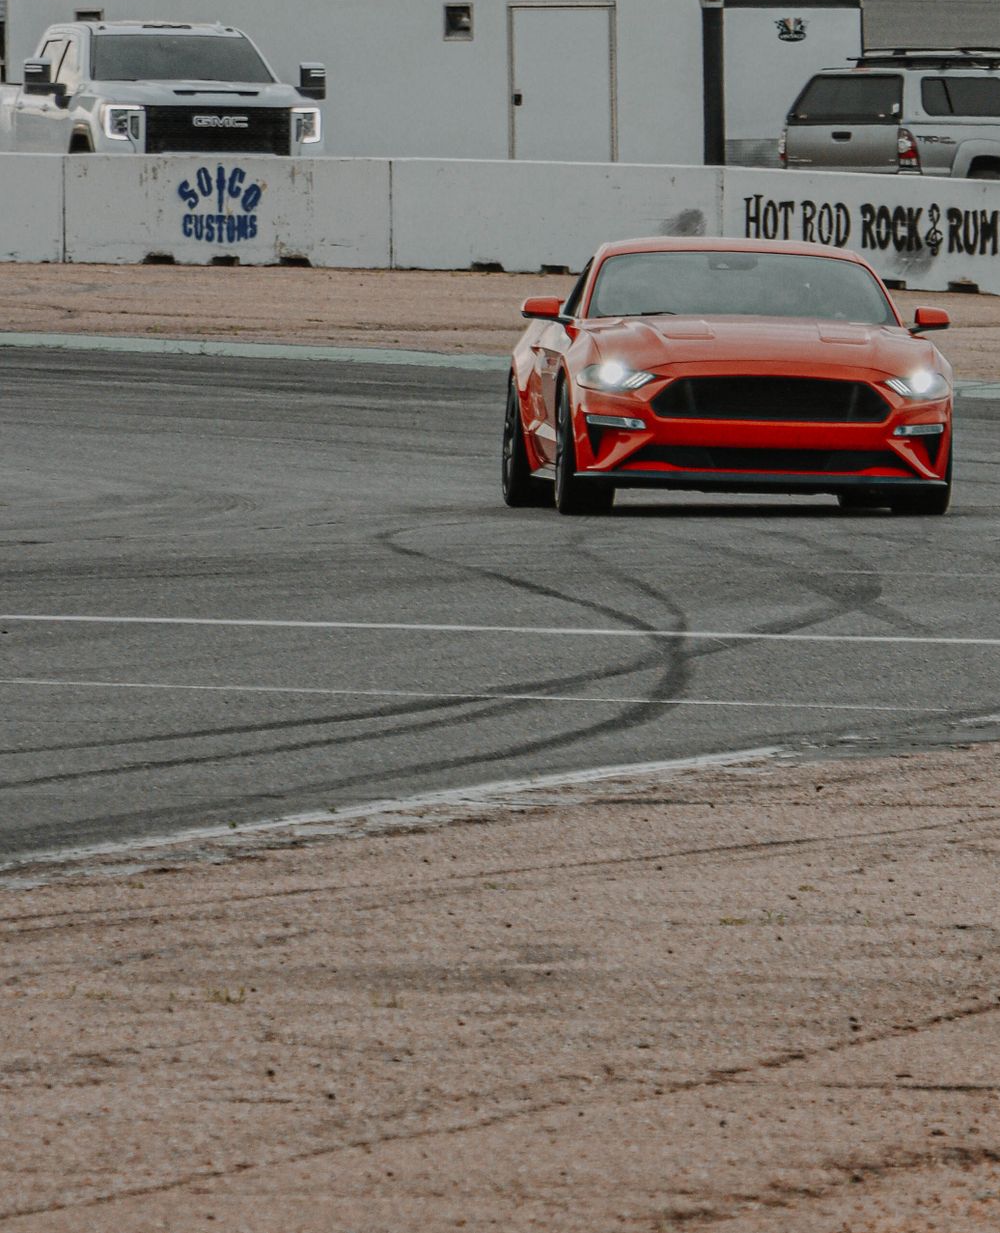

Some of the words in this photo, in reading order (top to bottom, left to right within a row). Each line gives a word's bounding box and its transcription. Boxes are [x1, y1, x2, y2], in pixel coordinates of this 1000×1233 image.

[192, 115, 249, 128] GMC
[182, 214, 257, 243] CUSTOMS
[744, 194, 794, 240] HOT
[800, 200, 850, 248] ROD
[860, 203, 923, 252] ROCK
